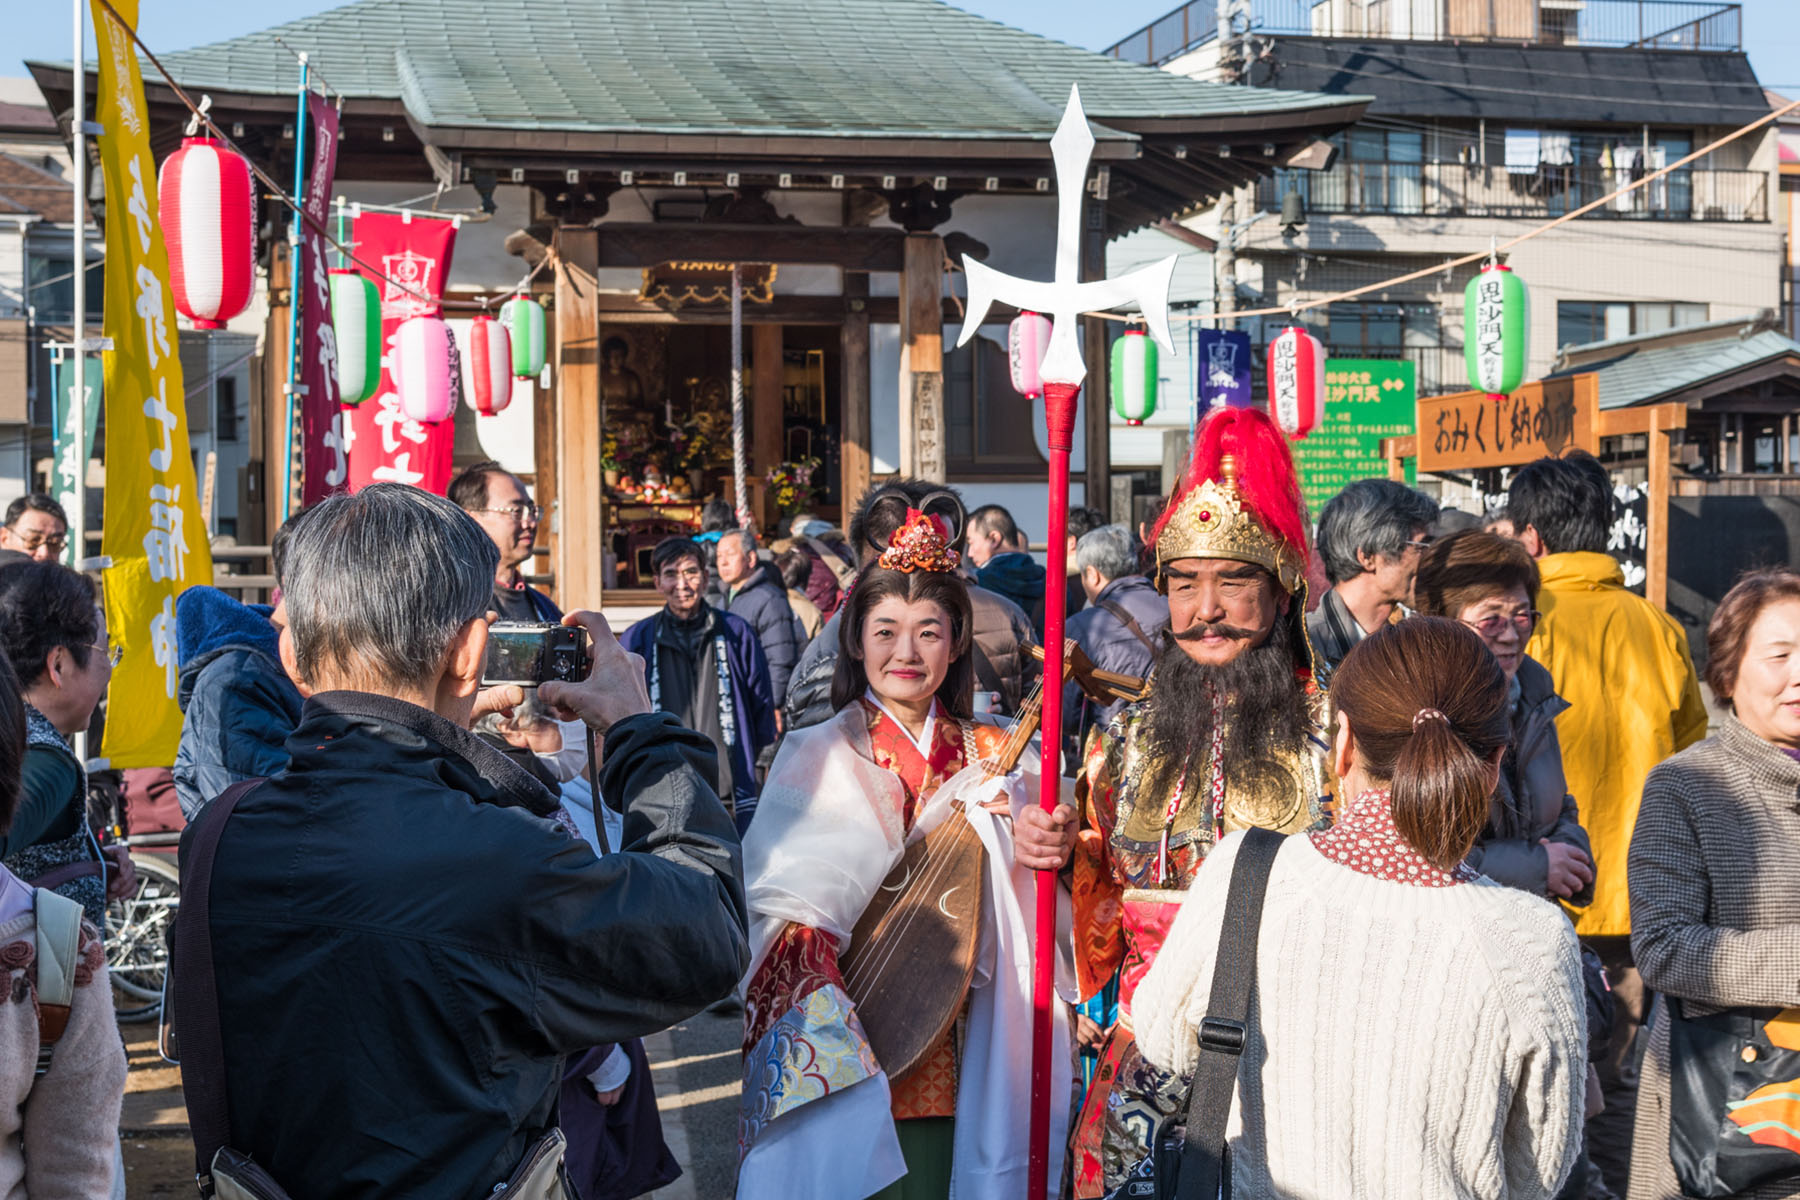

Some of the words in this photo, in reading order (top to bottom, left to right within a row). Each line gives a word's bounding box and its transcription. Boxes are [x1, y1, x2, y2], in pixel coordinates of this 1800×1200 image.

[1479, 281, 1504, 356] 毘沙門天
[1275, 340, 1298, 399] 毘沙門天
[1435, 391, 1577, 455] おみくじ納め所
